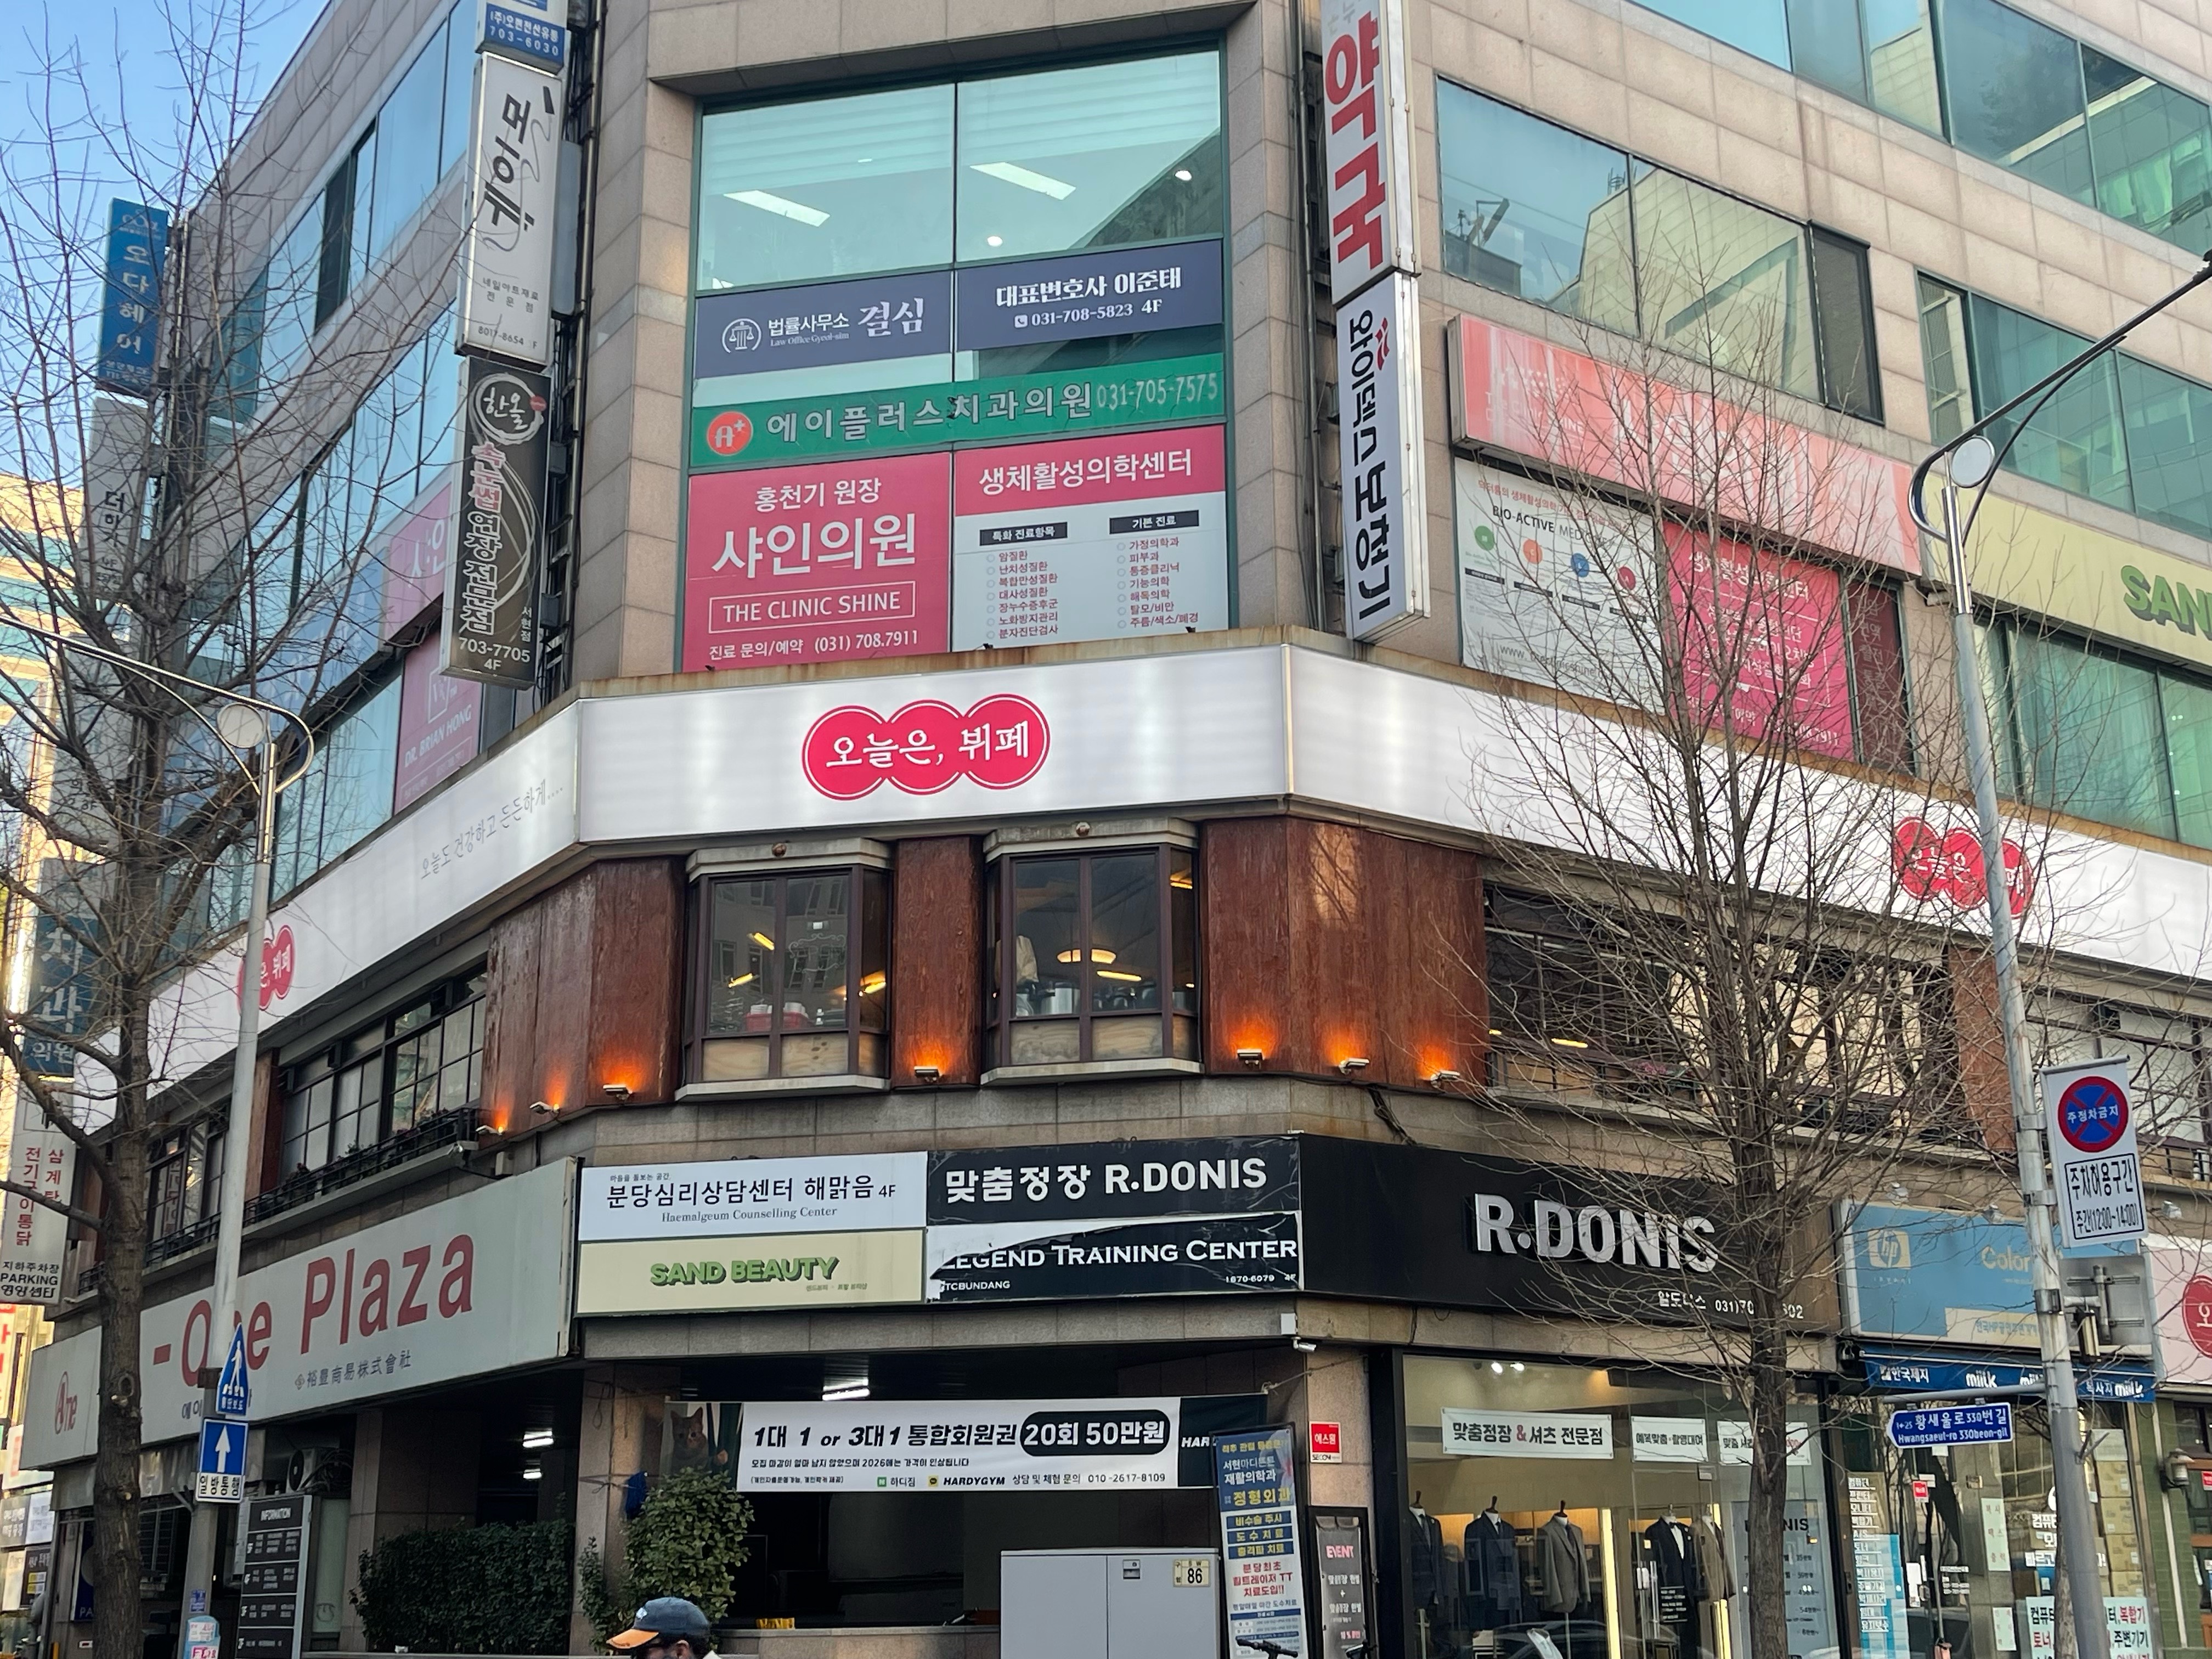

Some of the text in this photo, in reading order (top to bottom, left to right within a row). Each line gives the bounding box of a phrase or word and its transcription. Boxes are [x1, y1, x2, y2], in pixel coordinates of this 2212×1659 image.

[490, 25, 558, 55] 703-6030
[1325, 10, 1386, 270] 약국
[996, 267, 1182, 309] 대표변호사 이준태
[768, 297, 925, 339] 법률사무소 결심
[1031, 298, 1163, 328] 031-708-5823 4F
[788, 336, 810, 345] Office
[1096, 372, 1218, 411] 031-705-7575
[979, 449, 1192, 496] 생체활성의학센터
[754, 477, 882, 513] 홍천기 원장
[1155, 515, 1177, 527] 진료
[1492, 505, 1555, 533] BIO-ACTIVE
[712, 512, 916, 579] 샤인의원
[1129, 537, 1180, 551] 가정의학과
[1129, 552, 1159, 564] 피부과
[723, 590, 901, 623] THE CLINIC SHINE
[2121, 565, 2212, 641] SAN
[458, 636, 531, 663] 703-7705
[709, 630, 918, 661] 진료 문의/예약 (031) 708.7911
[483, 658, 501, 670] 4F
[419, 724, 445, 757] BRIAN
[446, 703, 472, 737] HONG
[826, 720, 1029, 768] 오늘은, 뷔페
[421, 847, 452, 880] 오늘도
[454, 815, 496, 858] 건강하고
[2067, 1104, 2119, 1124] 주정차금지
[606, 1173, 896, 1210] 분당심리상담센터 해맑음 4F
[946, 1157, 1268, 1204] 맞춤정장 R.DONIS
[2070, 1158, 2134, 1201] 주차허용구간
[662, 1205, 838, 1225] Haemalgeum Counselling Center
[1475, 1193, 1719, 1273] R.DONIS
[1051, 1244, 1179, 1266] TRAINING
[1185, 1239, 1298, 1261] CENTER
[0, 1273, 58, 1285] PARKING
[2, 1261, 60, 1274] 지하주차장
[650, 1256, 840, 1286] SAND BEAUTY
[300, 1233, 475, 1356] Plaza
[940, 1279, 1011, 1291] TCBUNDANG
[754, 1420, 1165, 1448] 1대 1 or 3대1 통합회원권 20회 50만원
[1181, 1436, 1211, 1448] HAR
[1453, 1421, 1604, 1446] 맞춤정장 & 셔츠 전문점
[1898, 1426, 2008, 1444] Hwangsaeul-ro 330beon-gil
[943, 1476, 1005, 1486] HARDYGYM
[1012, 1473, 1166, 1485] 상담 및 체험 문의 010-2617-8109
[1224, 1469, 1276, 1485] 재활의학과
[1233, 1487, 1291, 1506] 정형외과
[1325, 1545, 1354, 1559] EVENT
[1187, 1568, 1203, 1584] 86
[2120, 1606, 2146, 1624] 복합기
[2114, 1629, 2149, 1648] 주변기기
